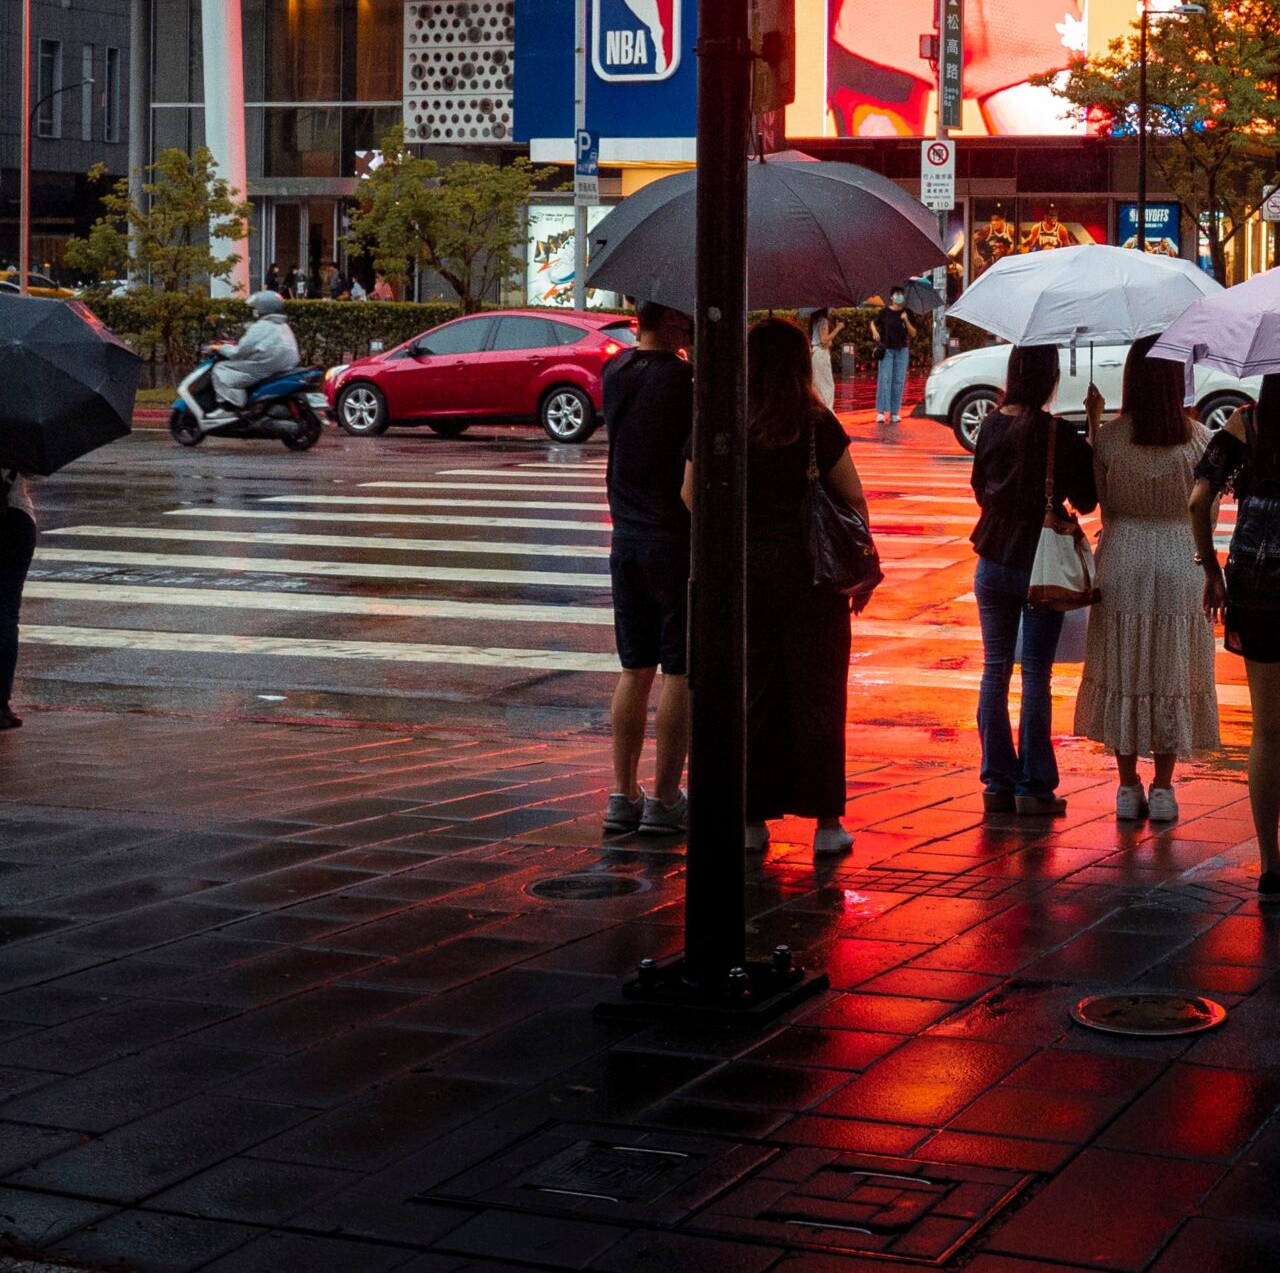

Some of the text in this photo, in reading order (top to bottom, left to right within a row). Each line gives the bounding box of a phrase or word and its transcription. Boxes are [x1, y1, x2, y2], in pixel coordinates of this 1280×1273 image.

[606, 30, 648, 65] NBA
[946, 13, 959, 80] 松高路
[578, 131, 591, 159] P
